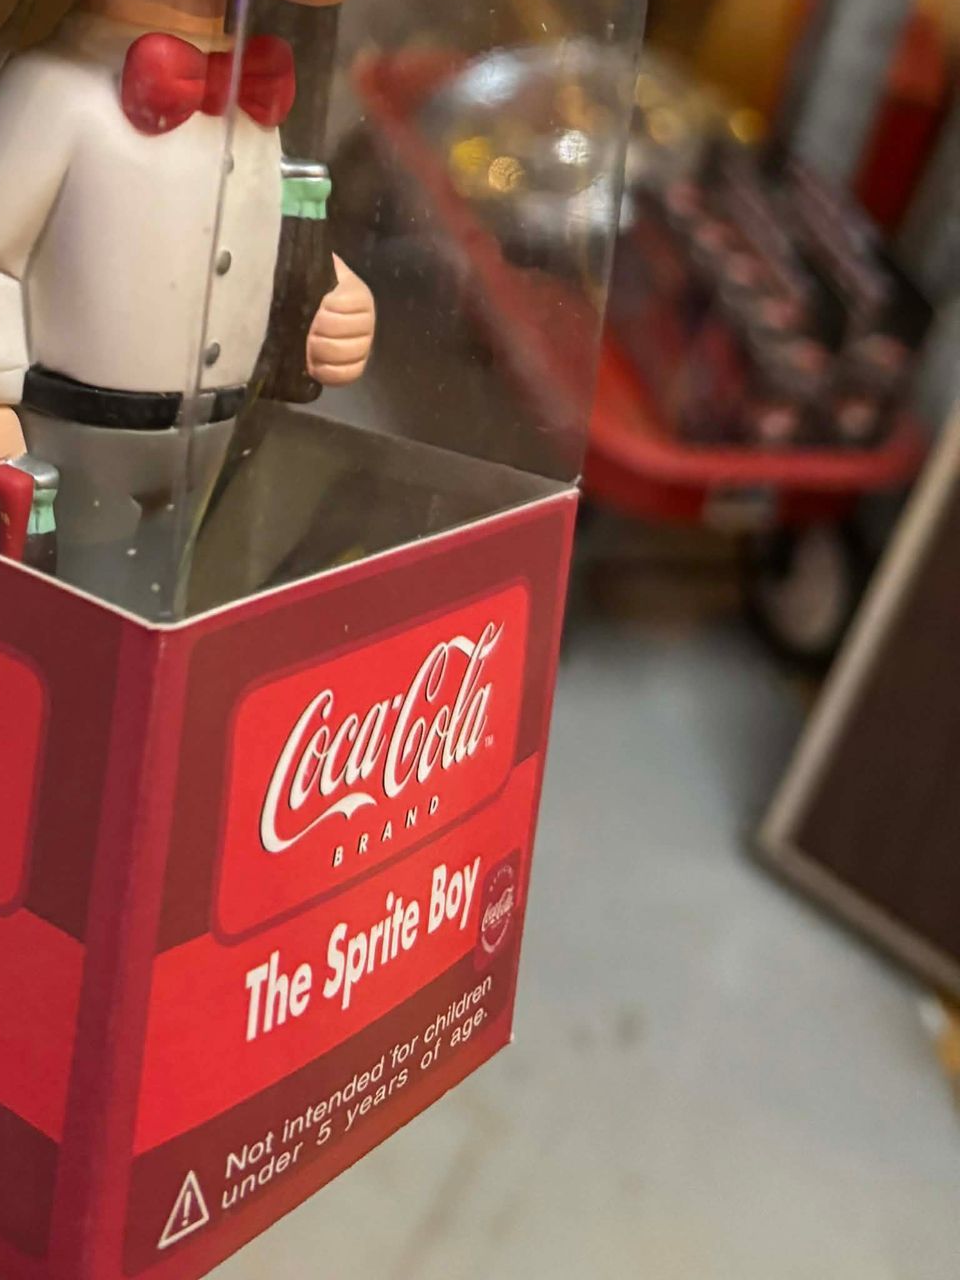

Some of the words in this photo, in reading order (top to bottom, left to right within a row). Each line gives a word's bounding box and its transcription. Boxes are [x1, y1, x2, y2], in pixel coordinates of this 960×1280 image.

[259, 621, 504, 853] Coca-Cola
[332, 795, 440, 868] BRAND
[245, 951, 312, 1042] The
[322, 891, 419, 1010] Sprite
[427, 856, 481, 933] Boy
[221, 1140, 303, 1209] under
[316, 1119, 333, 1146] 5
[344, 1068, 408, 1132] years
[420, 1037, 442, 1070] of
[450, 1007, 488, 1047] age.
[225, 1131, 274, 1179] Not
[281, 1055, 385, 1144] intended
[390, 1035, 419, 1068] for
[423, 975, 492, 1043] children
